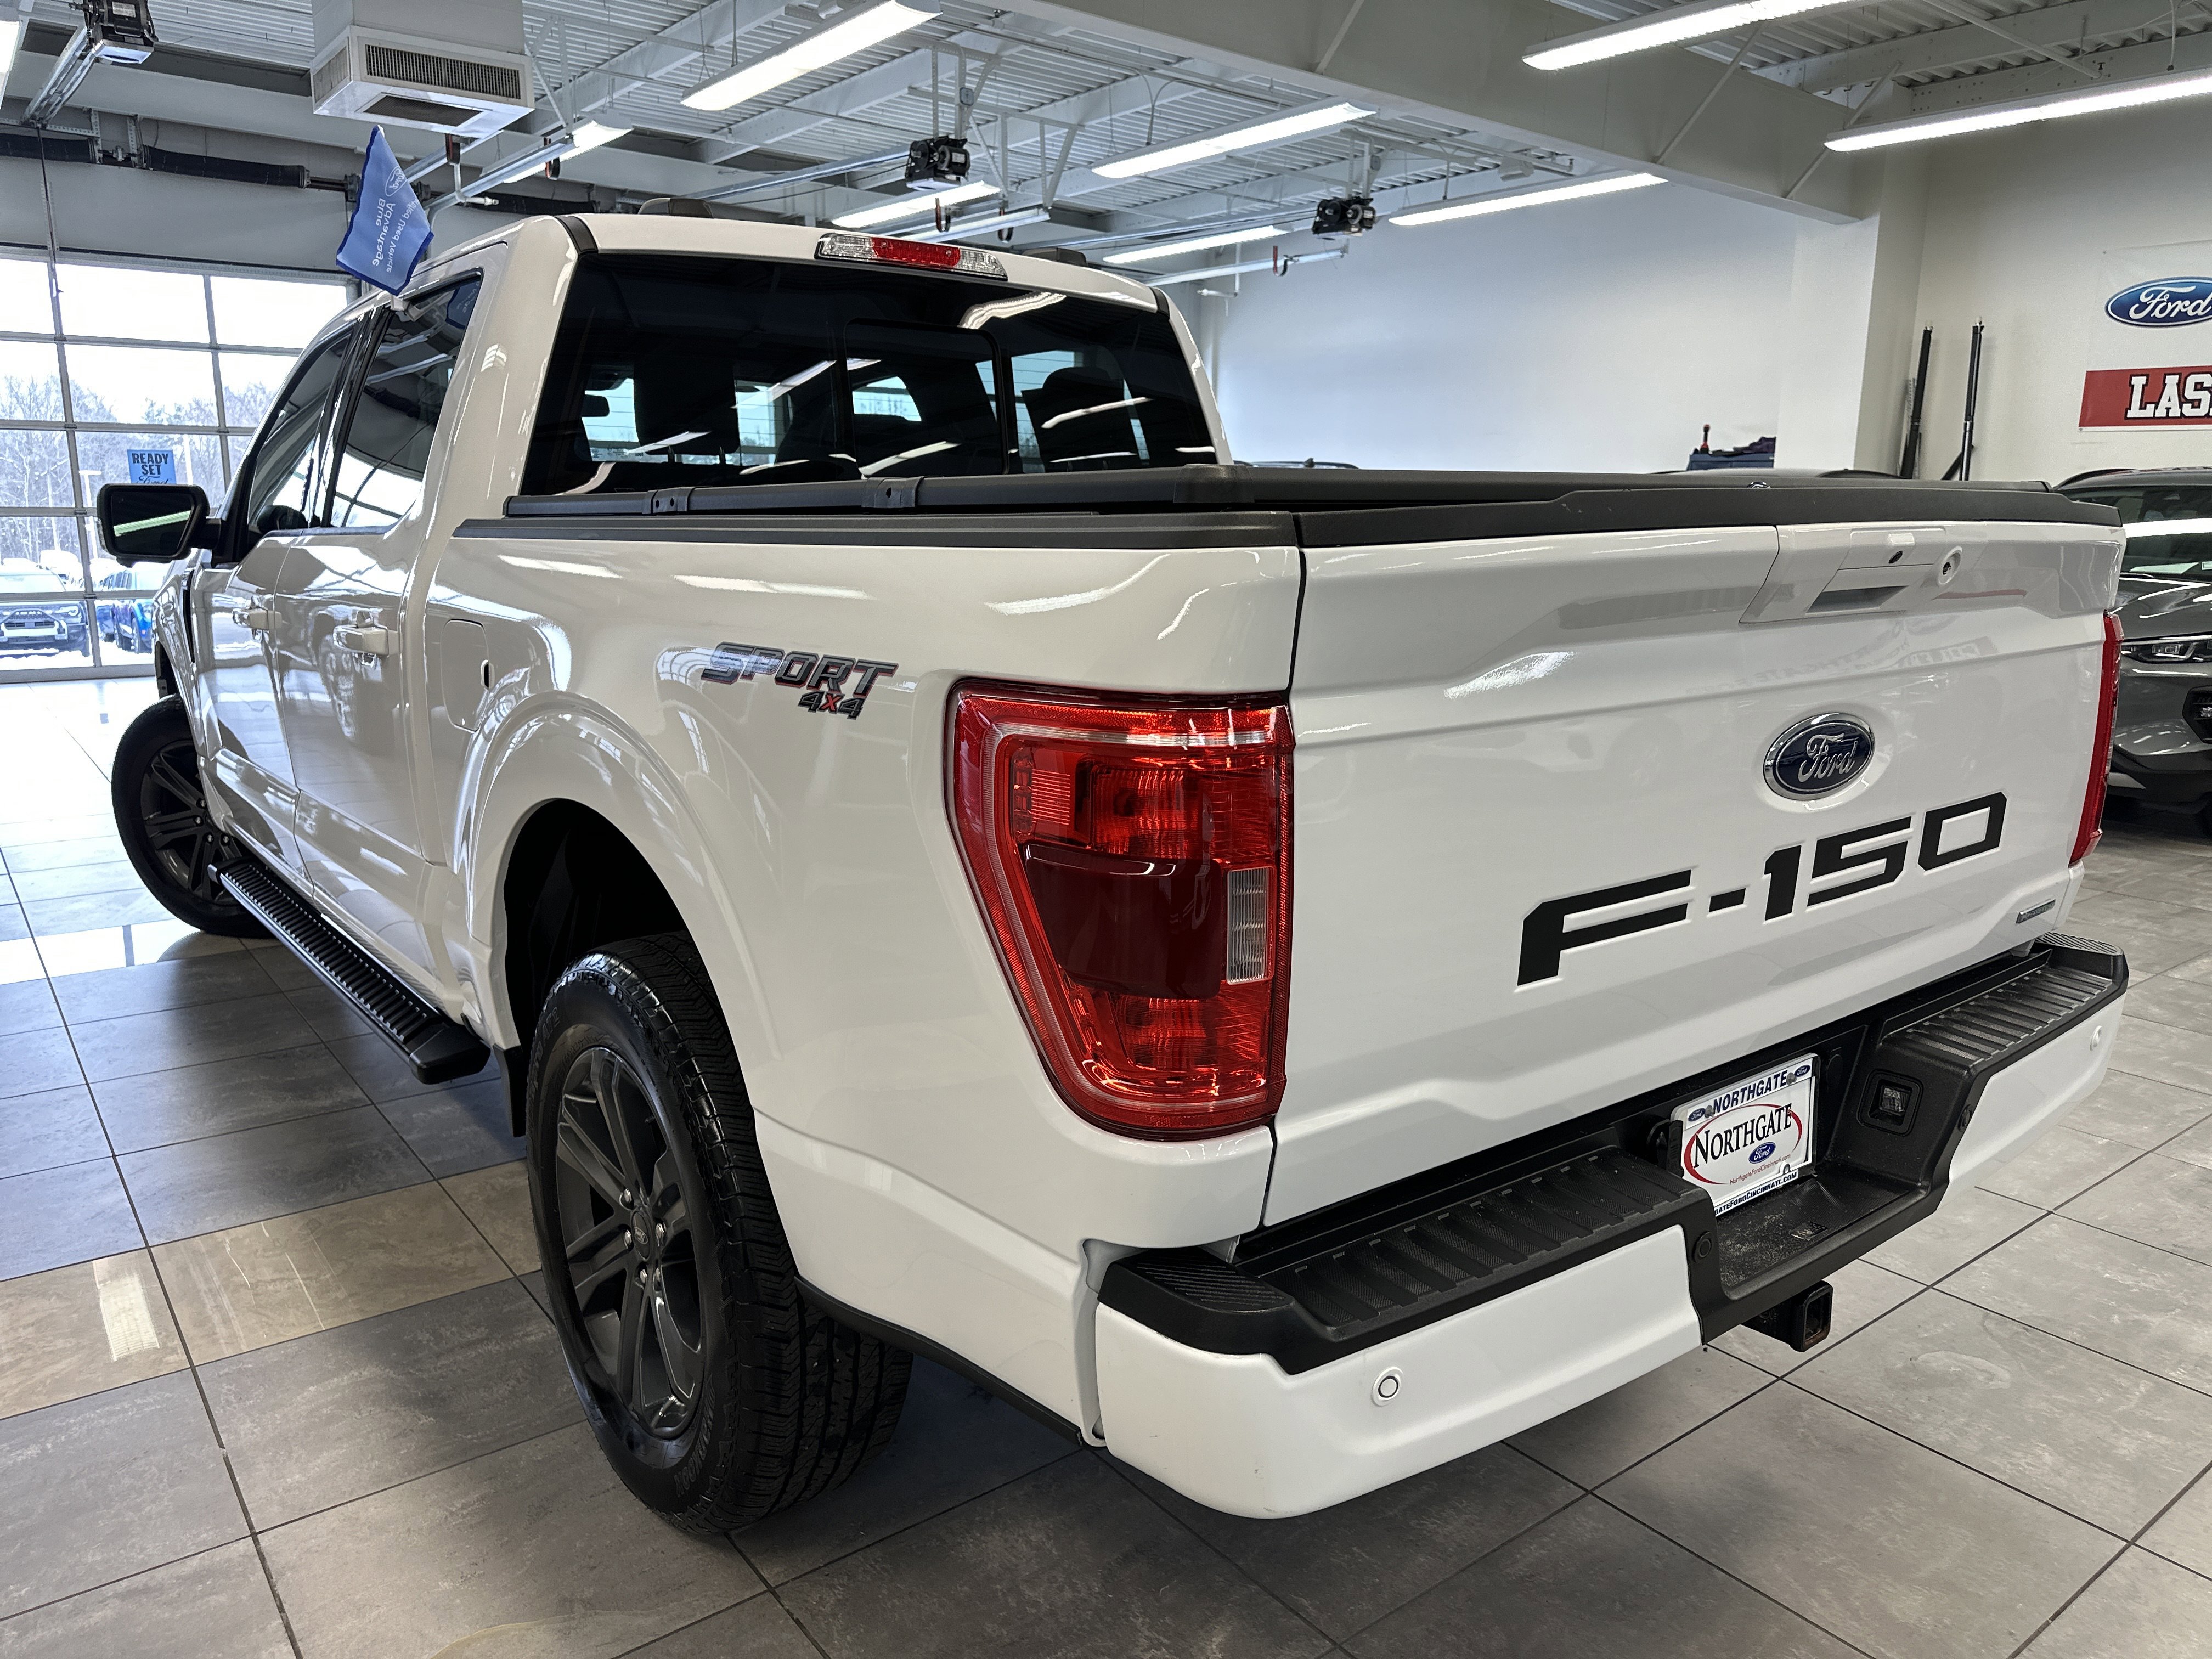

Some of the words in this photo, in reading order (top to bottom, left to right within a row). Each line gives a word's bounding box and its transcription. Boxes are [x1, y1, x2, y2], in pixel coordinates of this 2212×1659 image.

[2129, 285, 2212, 319] Ford
[2125, 372, 2212, 419] LAS
[132, 453, 168, 464] READY
[141, 465, 161, 475] SET
[701, 641, 899, 698] SPORT
[1798, 733, 1858, 782] Ford
[1517, 792, 2007, 986] F-150
[1713, 1070, 1788, 1115] NORTHGATE
[1729, 1154, 1791, 1186] NorthgateFordCincinnati.com
[1754, 1146, 1771, 1161] Ford
[1714, 1172, 1797, 1215] GATEFORDCINCINNATI.COM
